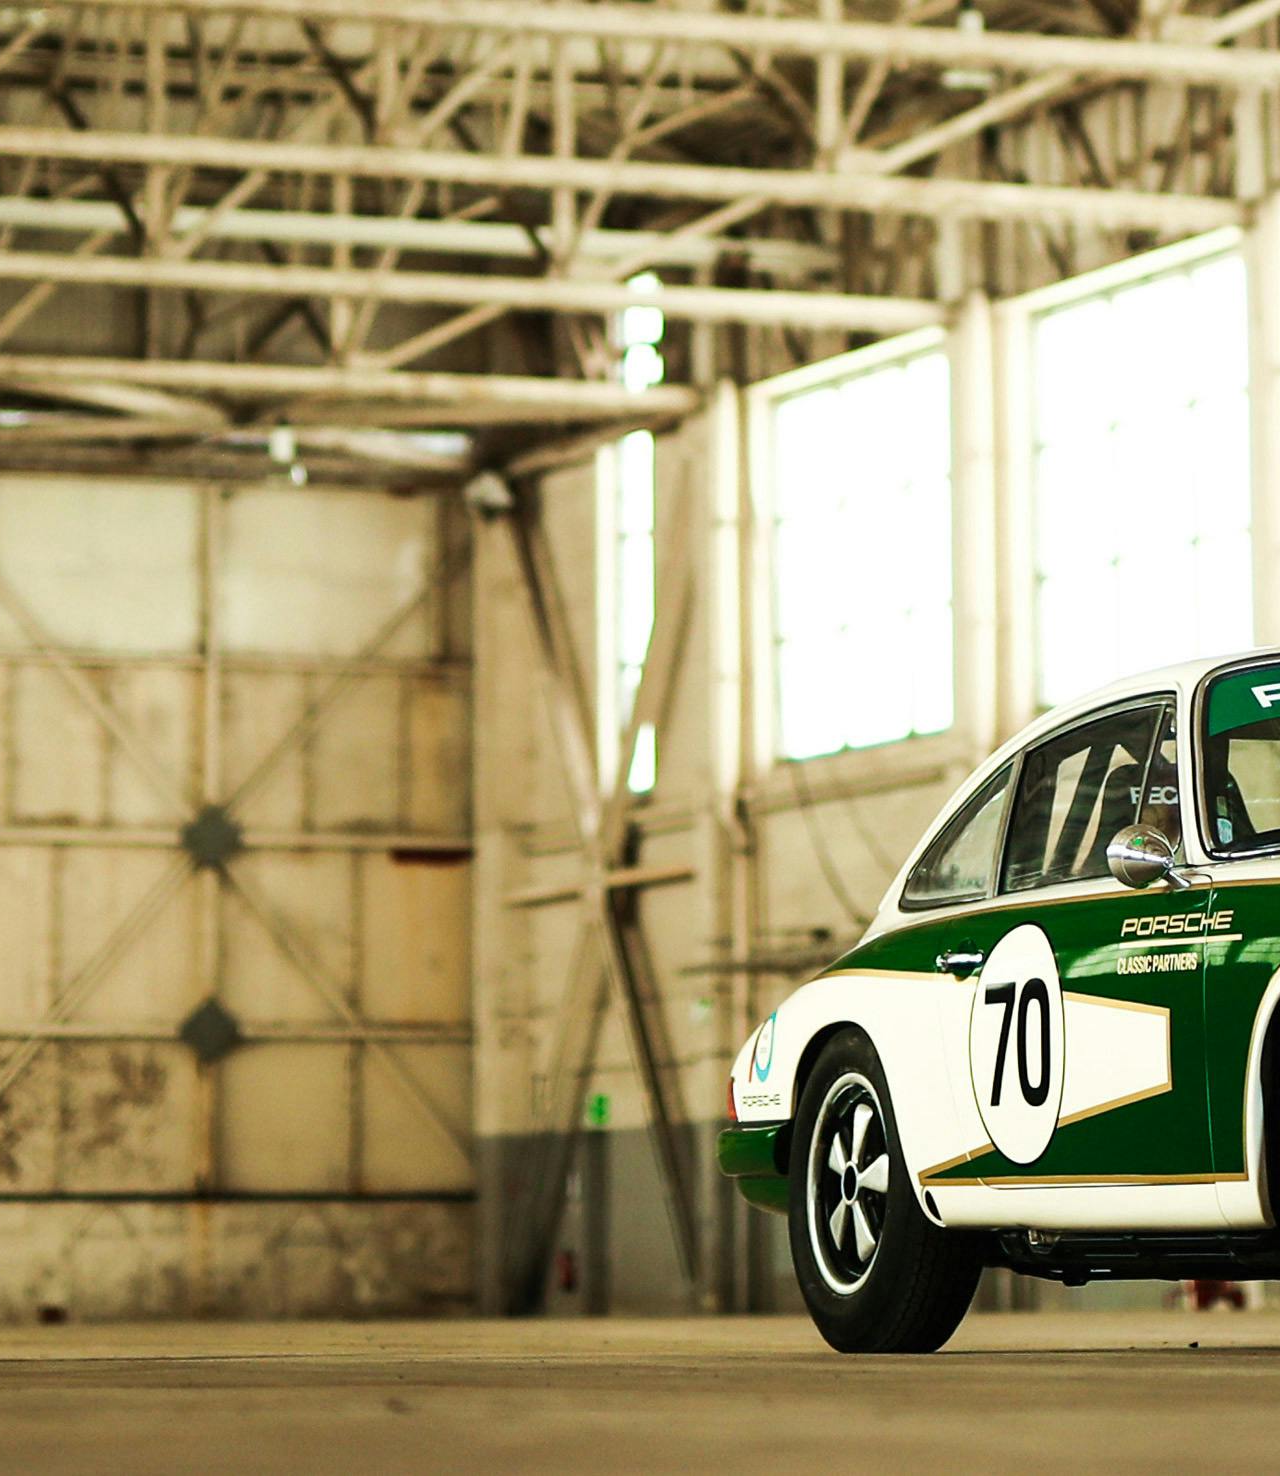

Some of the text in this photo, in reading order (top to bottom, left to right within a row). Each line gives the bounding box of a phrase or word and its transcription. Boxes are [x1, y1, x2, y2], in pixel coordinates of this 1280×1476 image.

[1121, 910, 1234, 937] PORSCHE
[1117, 952, 1198, 975] CLASSIC PARTNERS
[985, 977, 1051, 1107] 70
